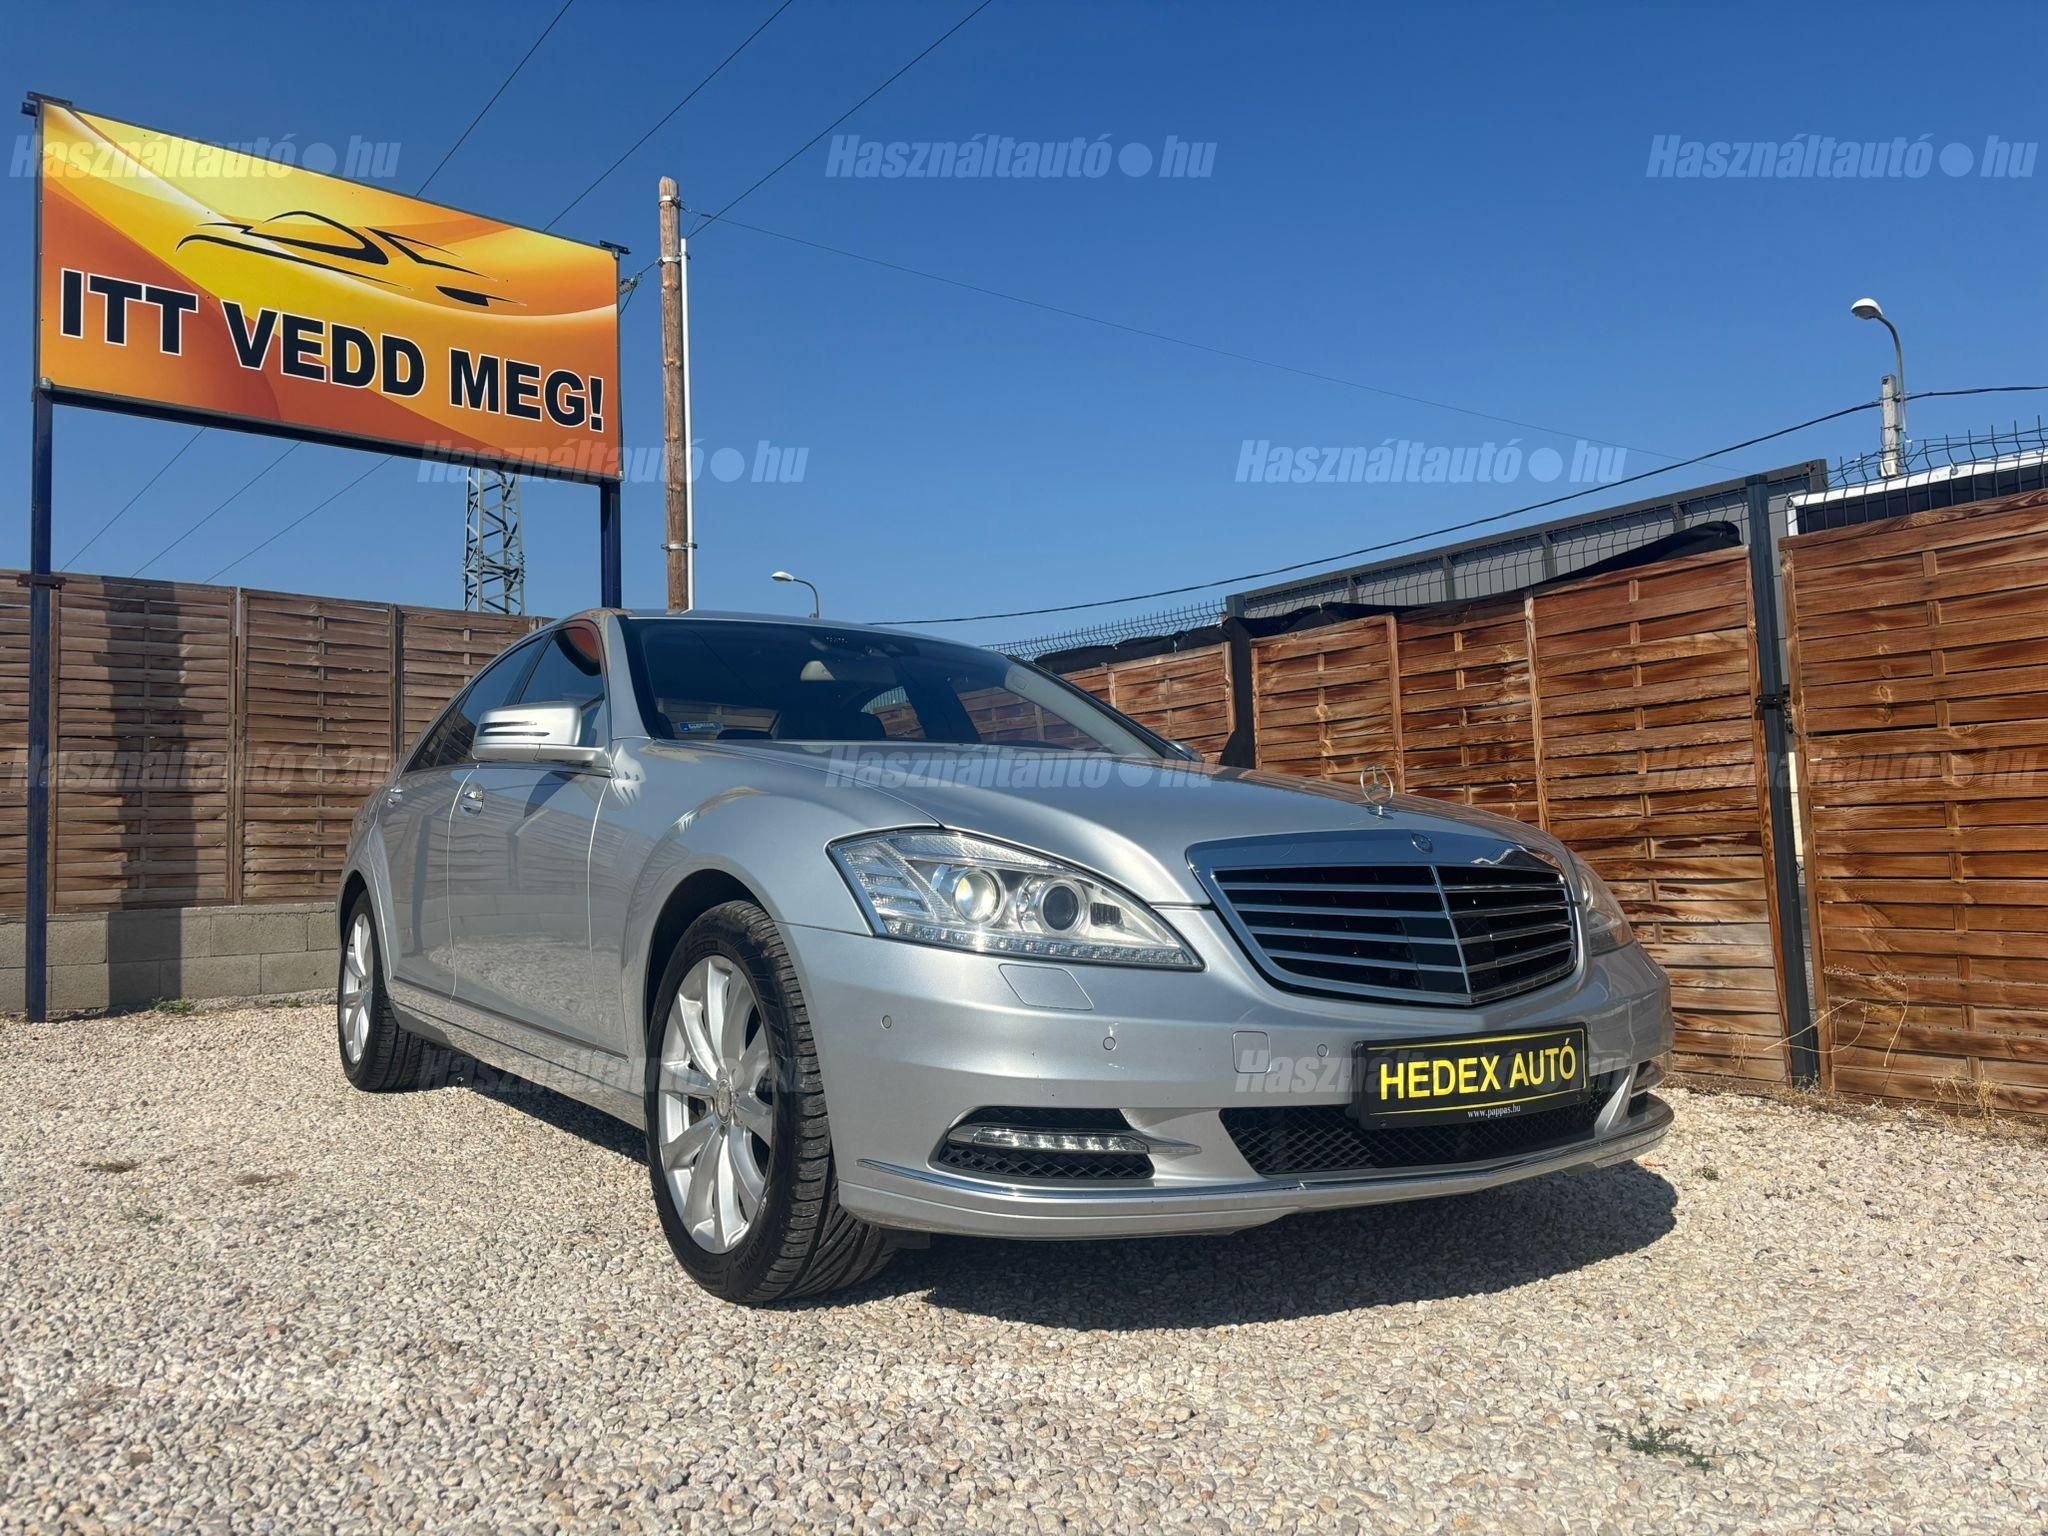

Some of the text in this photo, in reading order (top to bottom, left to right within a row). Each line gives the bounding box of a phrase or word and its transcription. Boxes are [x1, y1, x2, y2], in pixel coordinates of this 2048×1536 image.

[60, 267, 605, 433] ITT VEDD MEG!
[1380, 1037, 1577, 1101] HEDEX AUTÓ
[1467, 1104, 1522, 1120] www.pappas.hu
